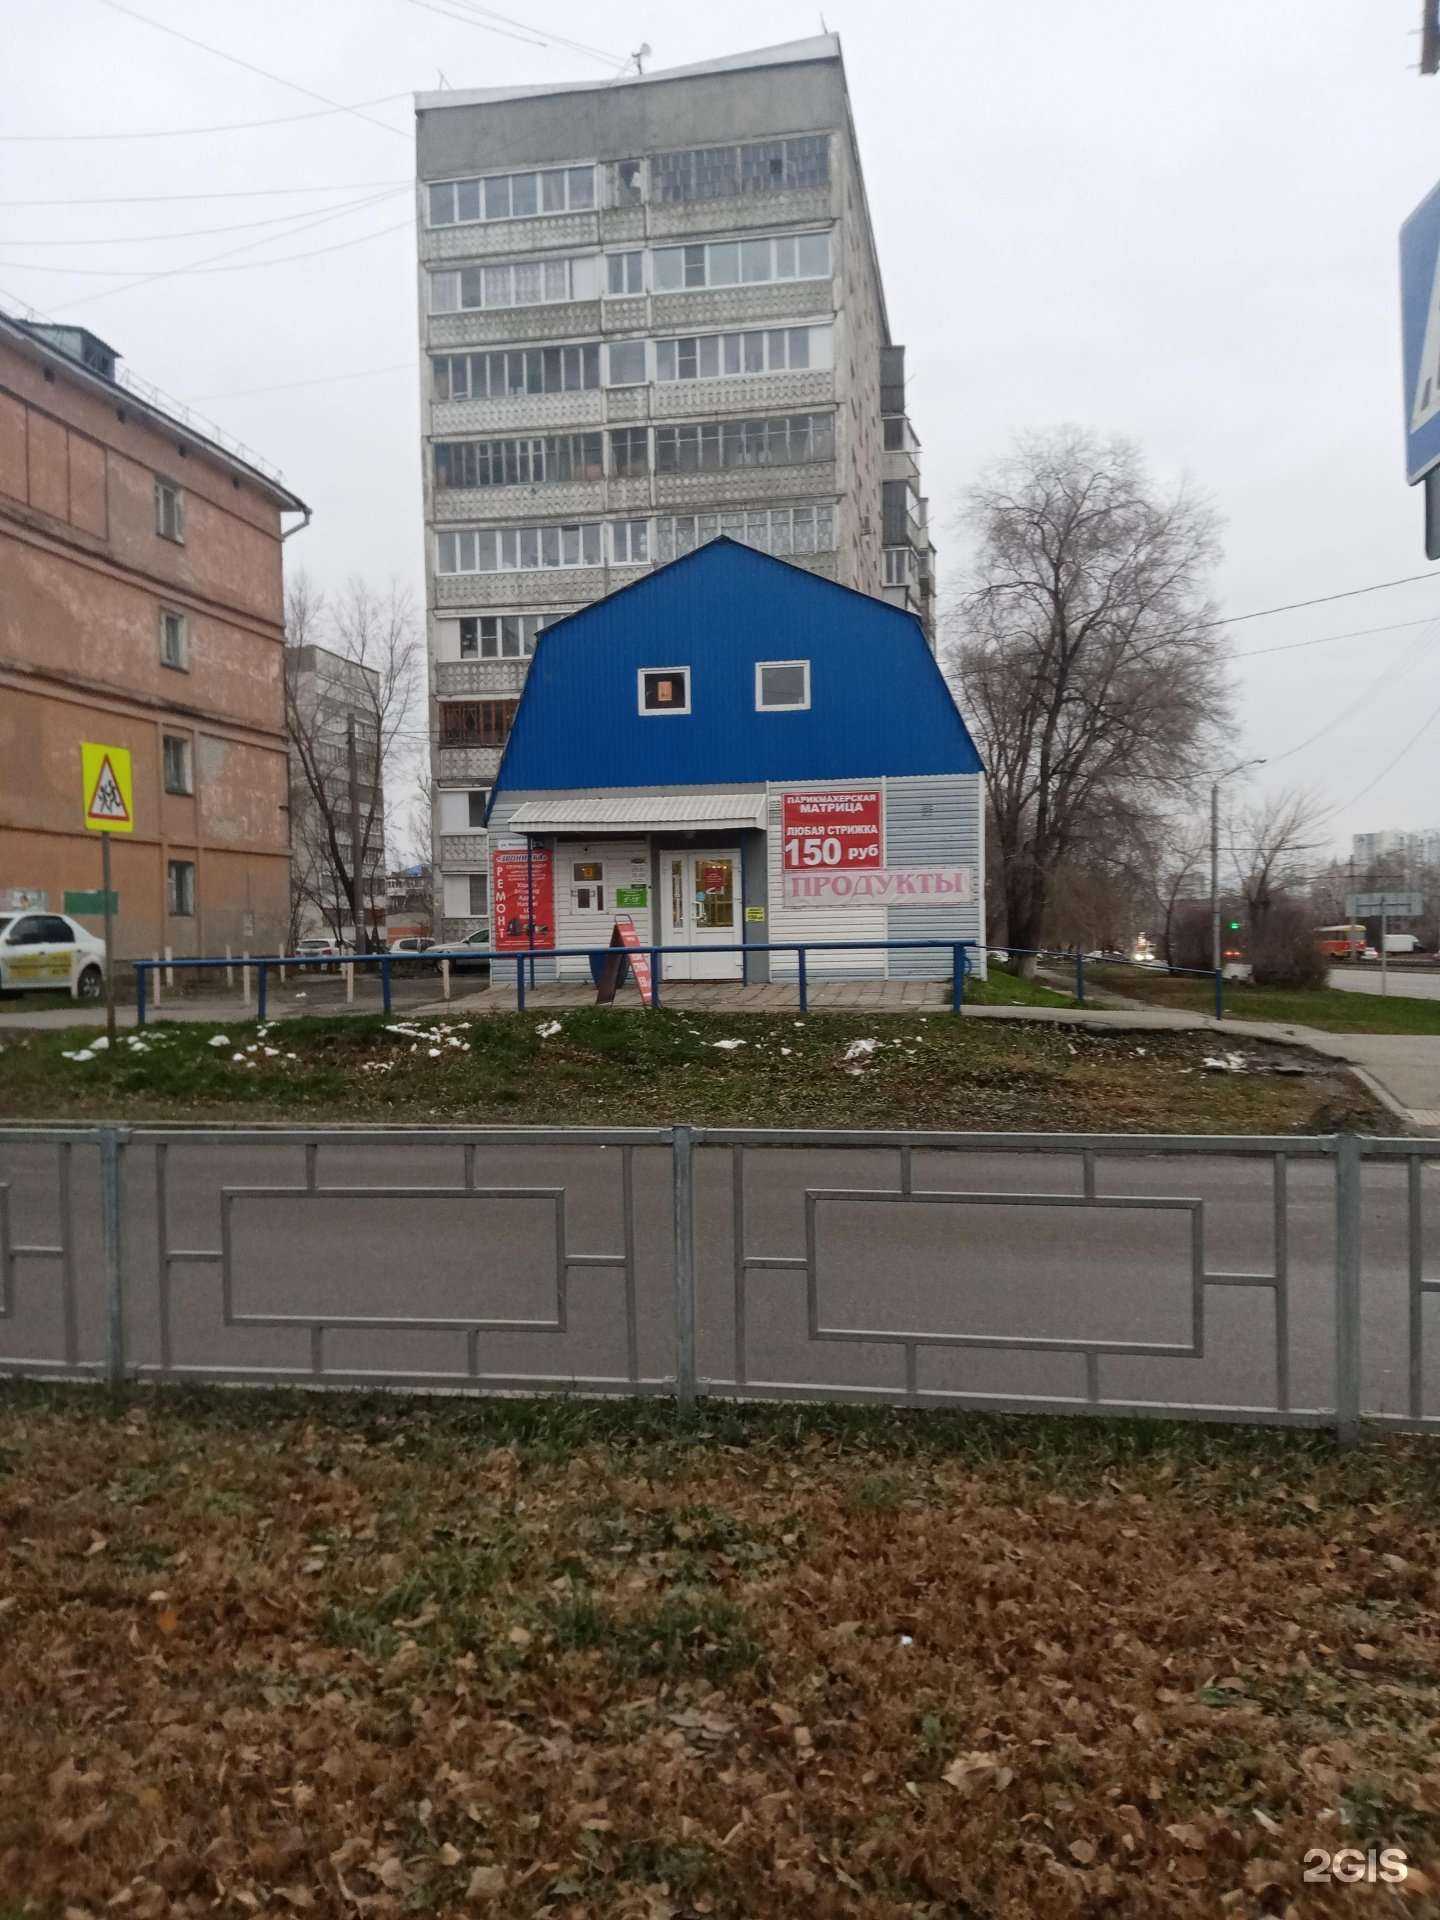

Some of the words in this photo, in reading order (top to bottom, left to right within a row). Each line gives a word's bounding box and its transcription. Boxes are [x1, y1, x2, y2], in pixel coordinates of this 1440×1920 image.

[787, 794, 876, 804] ПАРИКМАХЕРСКАЯ
[800, 802, 864, 813] МАТРИЦА
[786, 826, 825, 836] ЛЮБАЯ
[827, 824, 879, 835] СТРИЖКА
[785, 837, 842, 866] 150
[848, 844, 879, 860] руб
[791, 872, 963, 898] ПРОДУКТЫ
